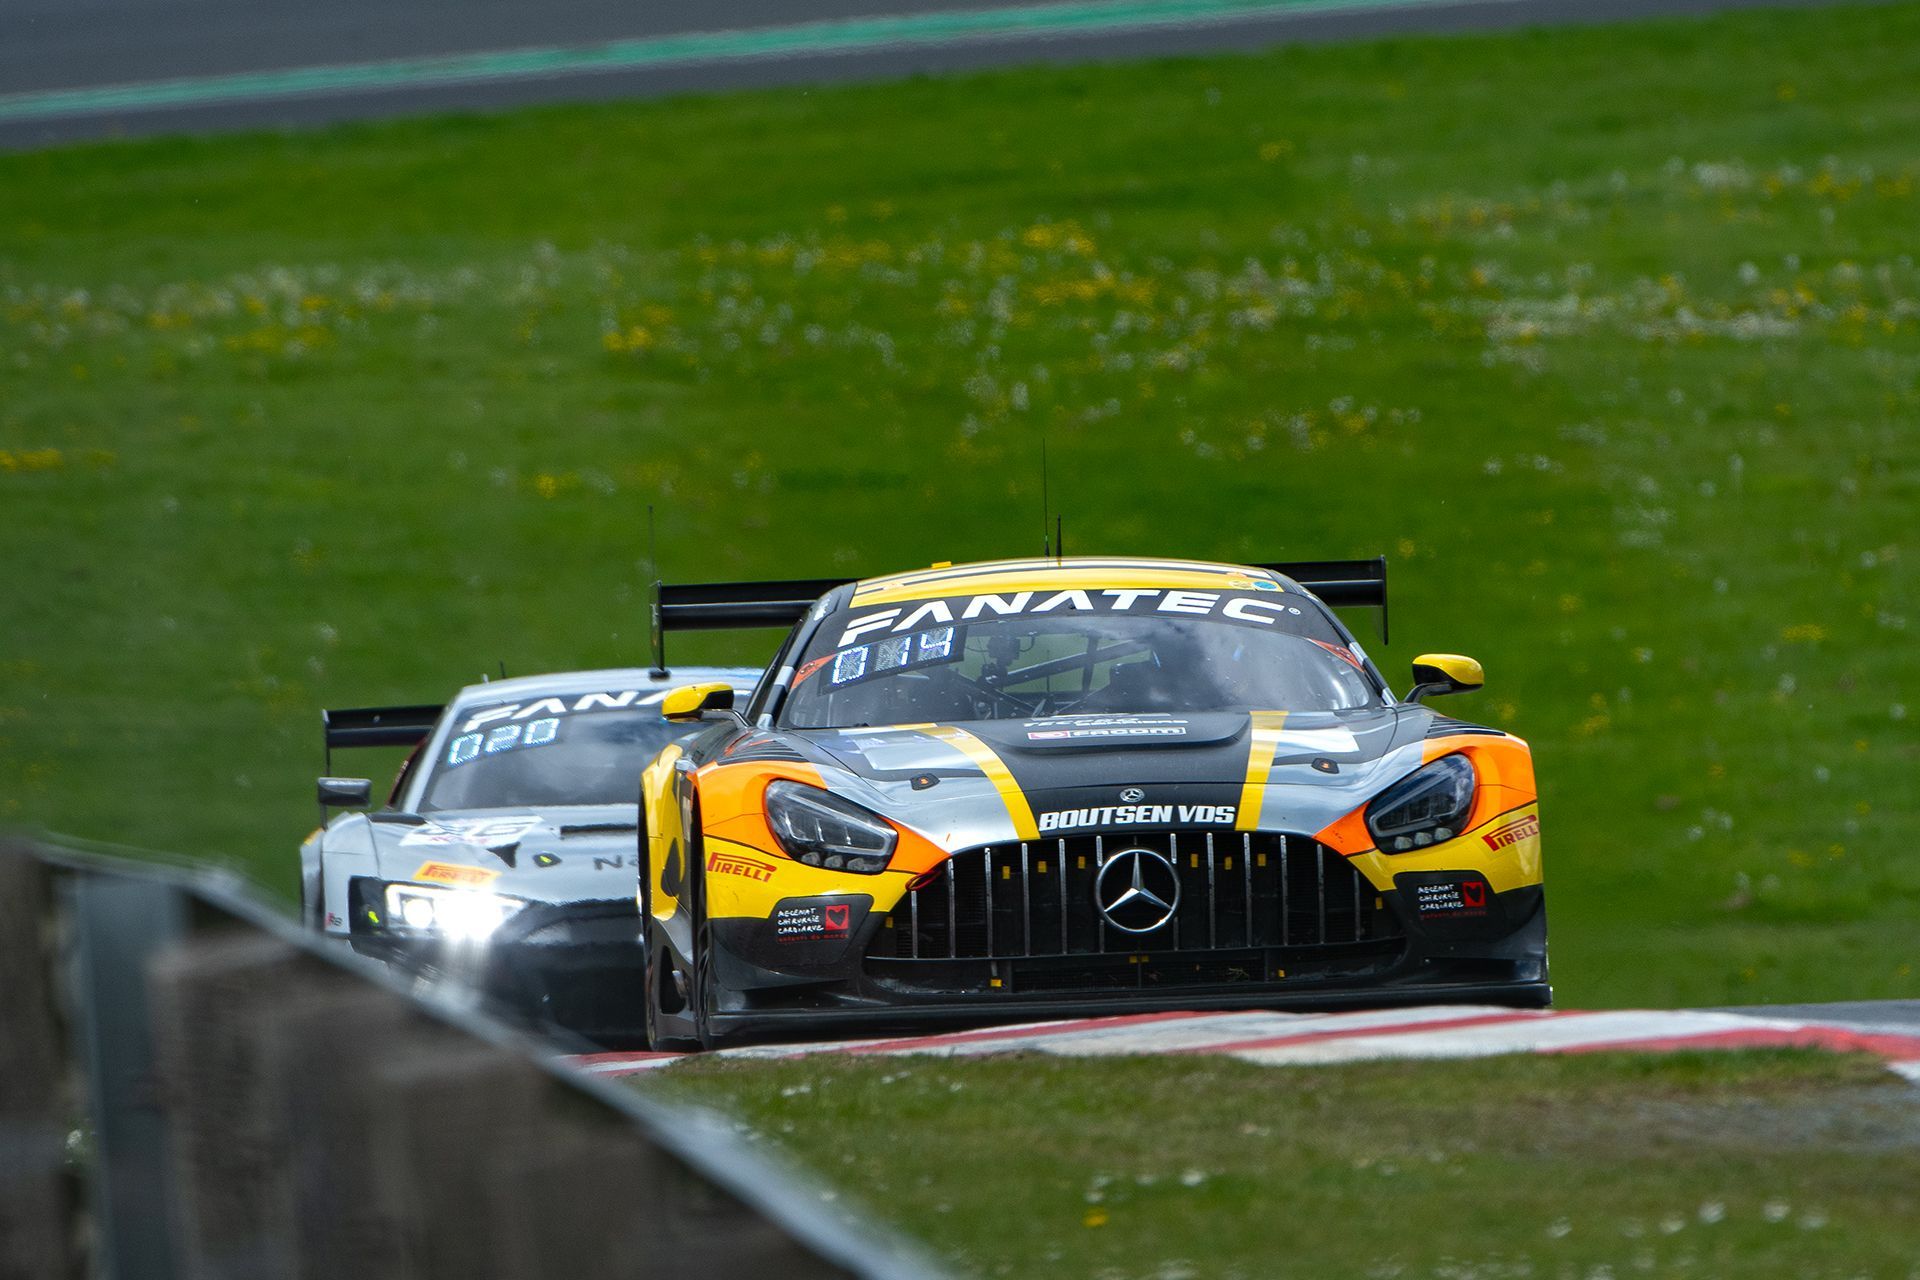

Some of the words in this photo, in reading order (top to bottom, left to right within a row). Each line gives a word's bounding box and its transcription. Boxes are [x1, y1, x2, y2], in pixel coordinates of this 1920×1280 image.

[837, 589, 1284, 648] FANATEC
[448, 717, 561, 765] 020
[1039, 805, 1173, 832] BOUTSEN
[1178, 805, 1236, 824] VDS
[707, 852, 777, 883] PIRELLI
